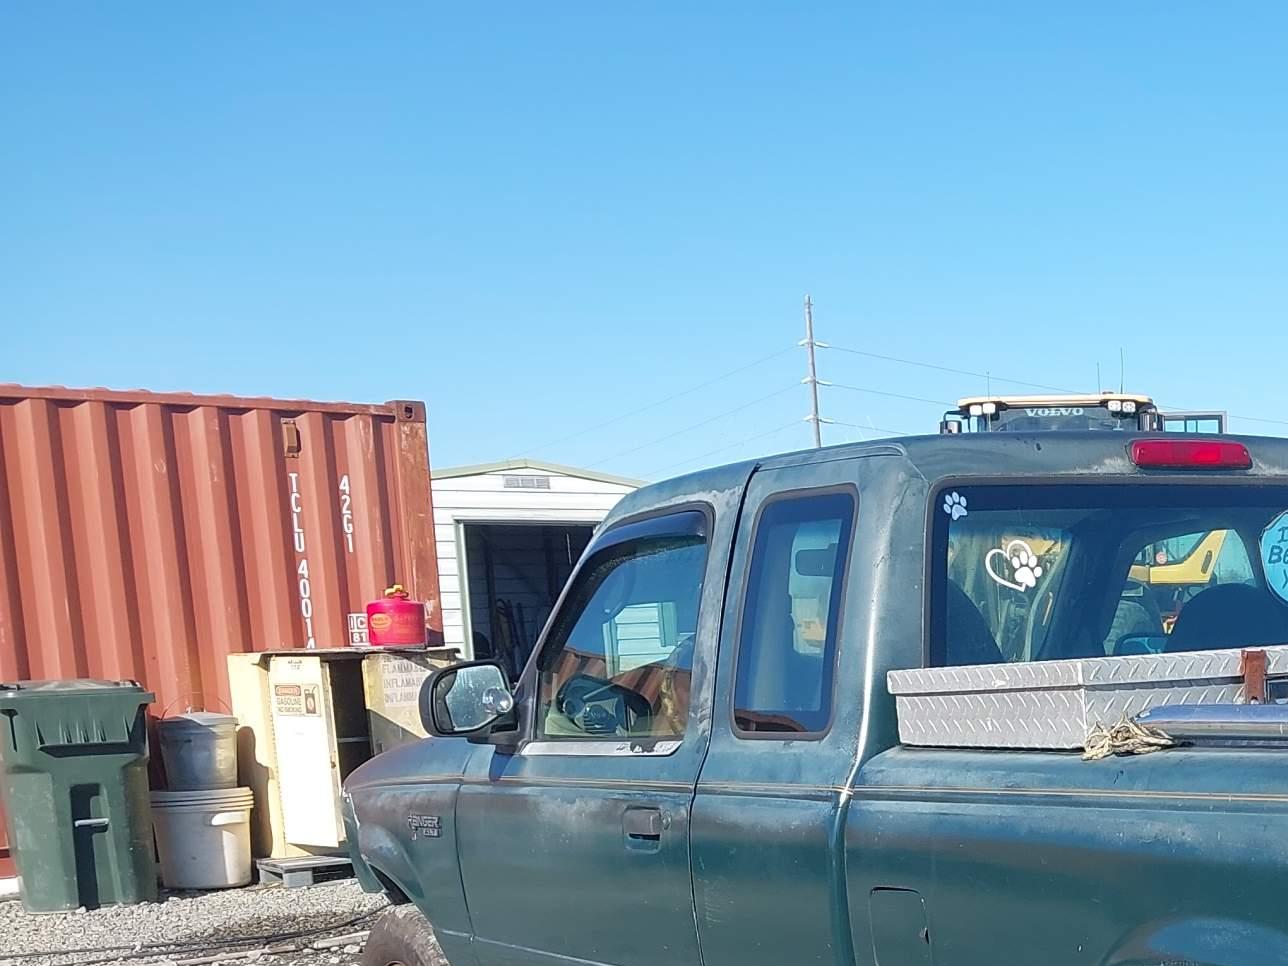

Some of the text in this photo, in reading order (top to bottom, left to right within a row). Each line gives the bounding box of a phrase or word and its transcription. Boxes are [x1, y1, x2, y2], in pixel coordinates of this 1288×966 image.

[1024, 407, 1084, 417] VOLVO
[289, 473, 305, 552] TCLU
[339, 475, 353, 552] 42G1
